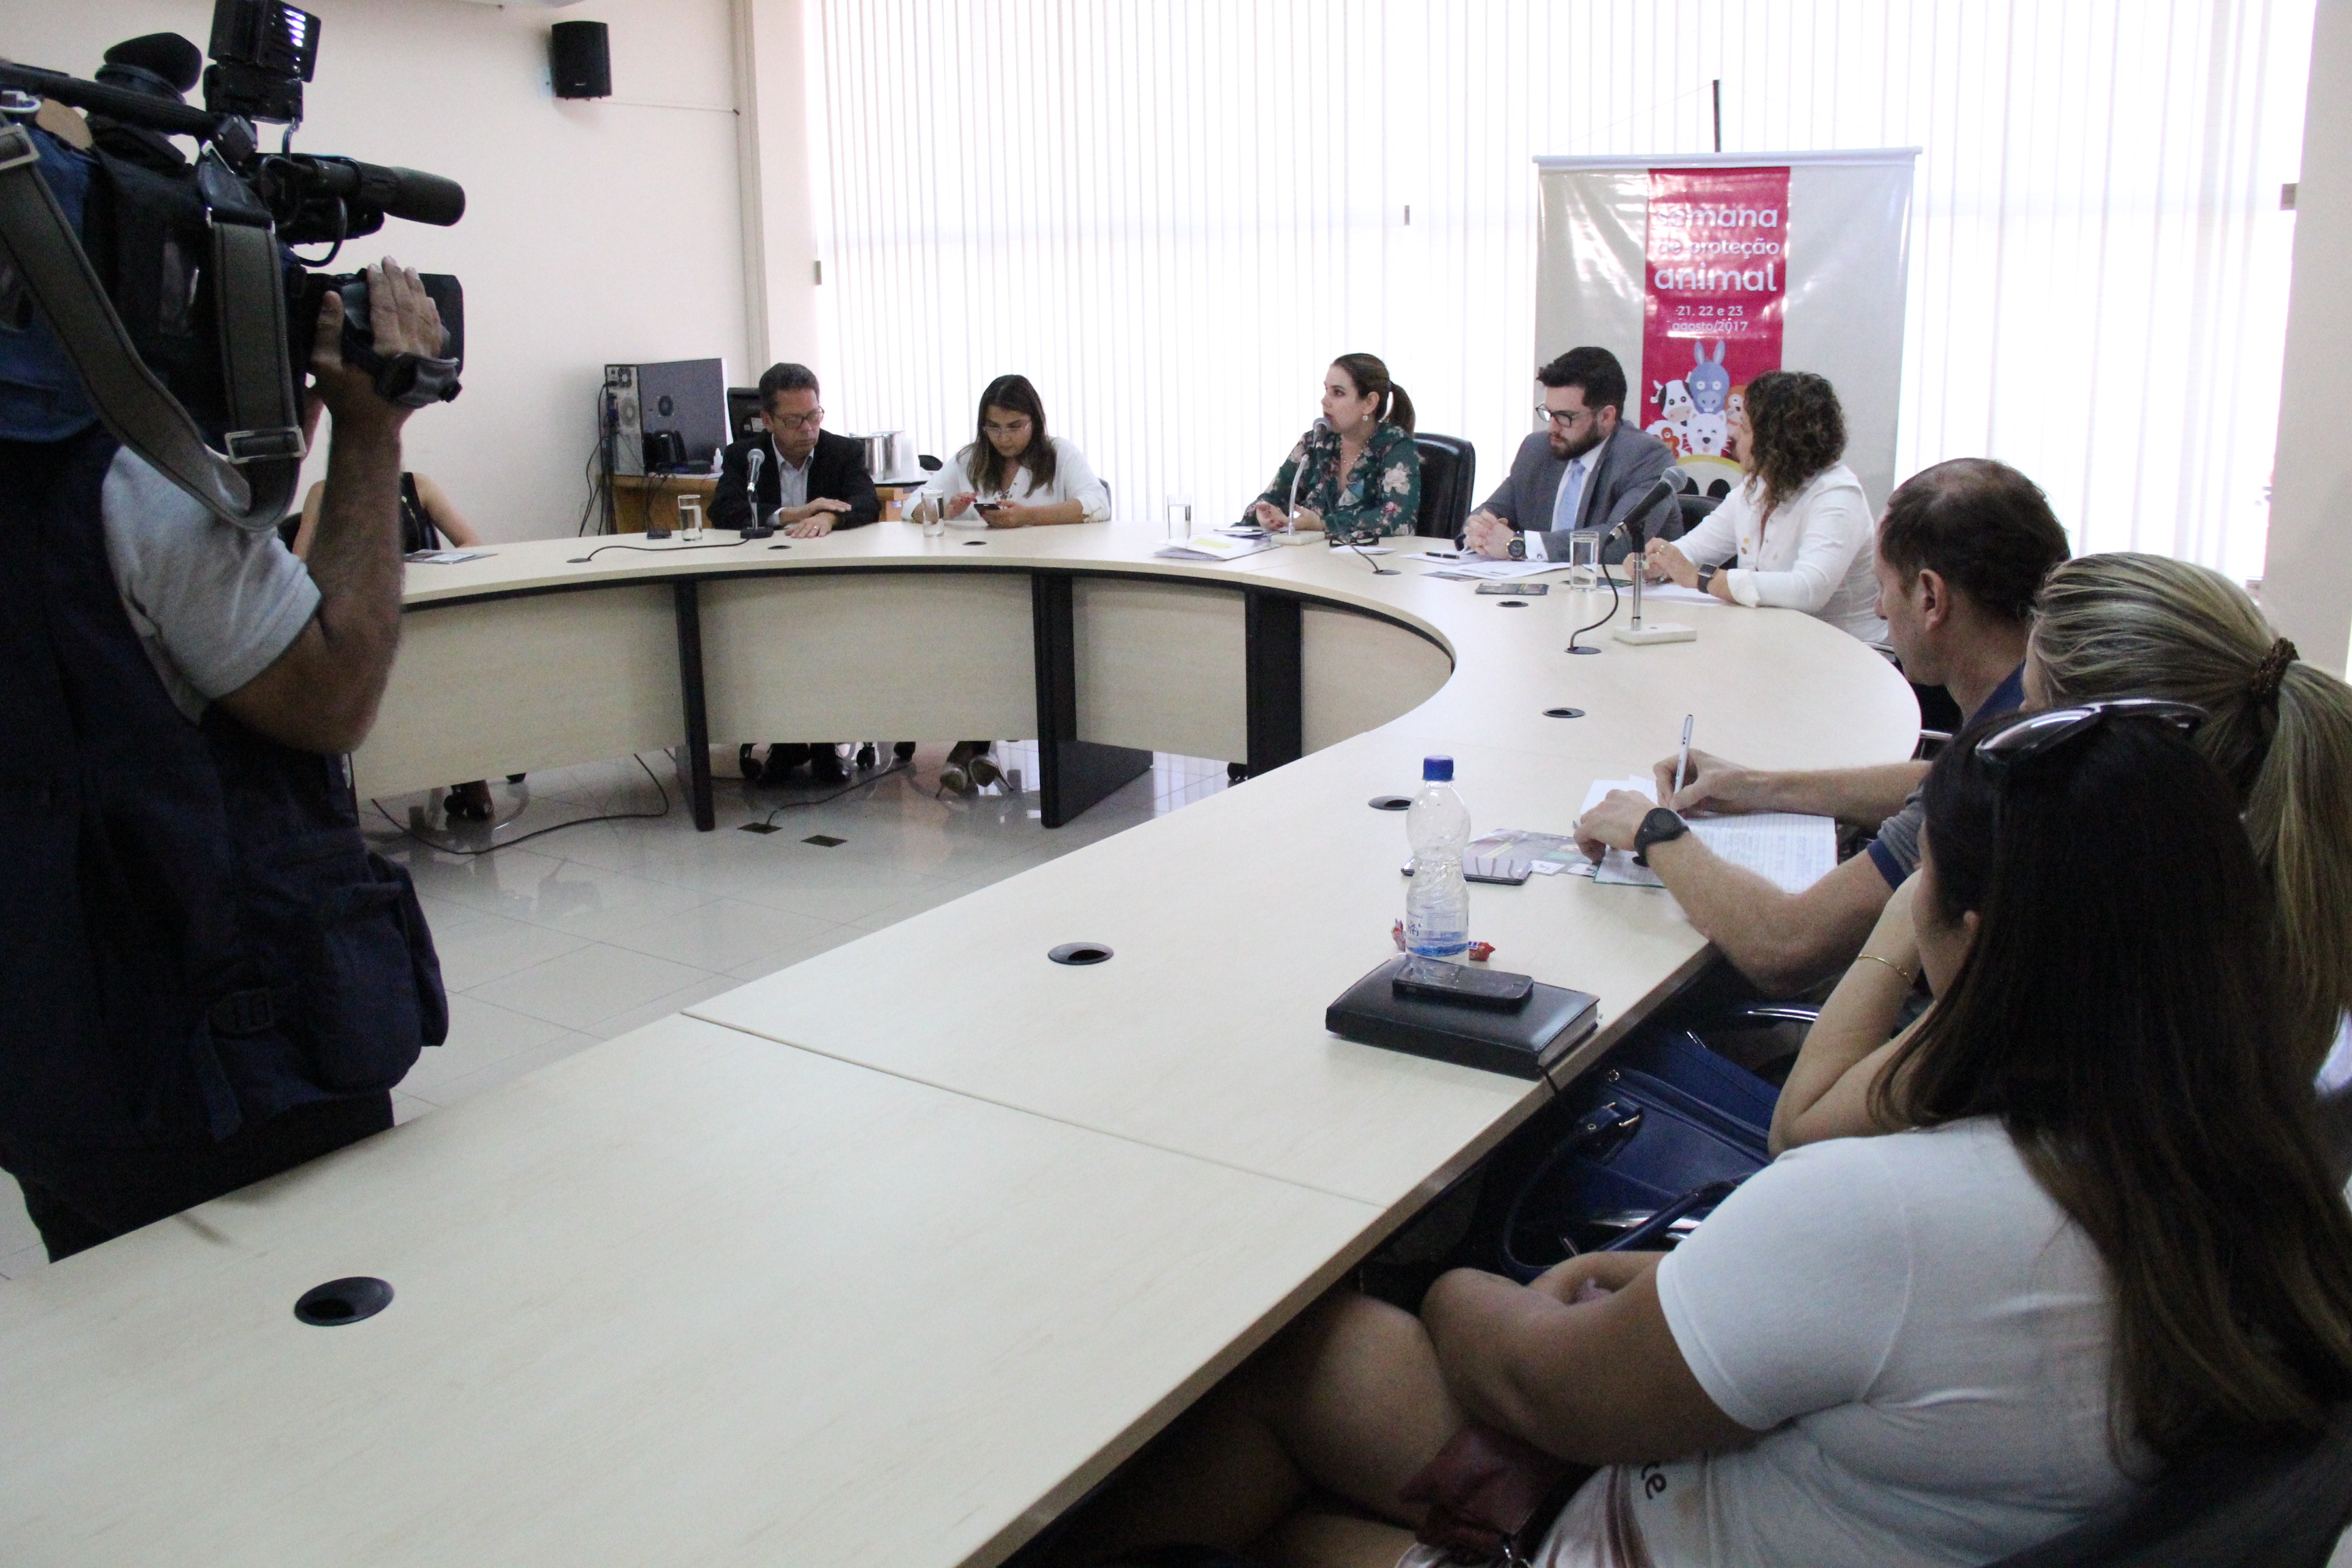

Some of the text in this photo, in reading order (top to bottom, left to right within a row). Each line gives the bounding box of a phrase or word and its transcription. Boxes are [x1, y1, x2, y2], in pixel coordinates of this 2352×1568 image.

[1657, 208, 1778, 227] semana
[1690, 238, 1780, 259] proteção
[1654, 262, 1778, 292] animal
[1699, 306, 1714, 316] 22
[1717, 308, 1725, 316] e
[1728, 306, 1743, 316] 23
[1672, 321, 1748, 331] agosto/2017
